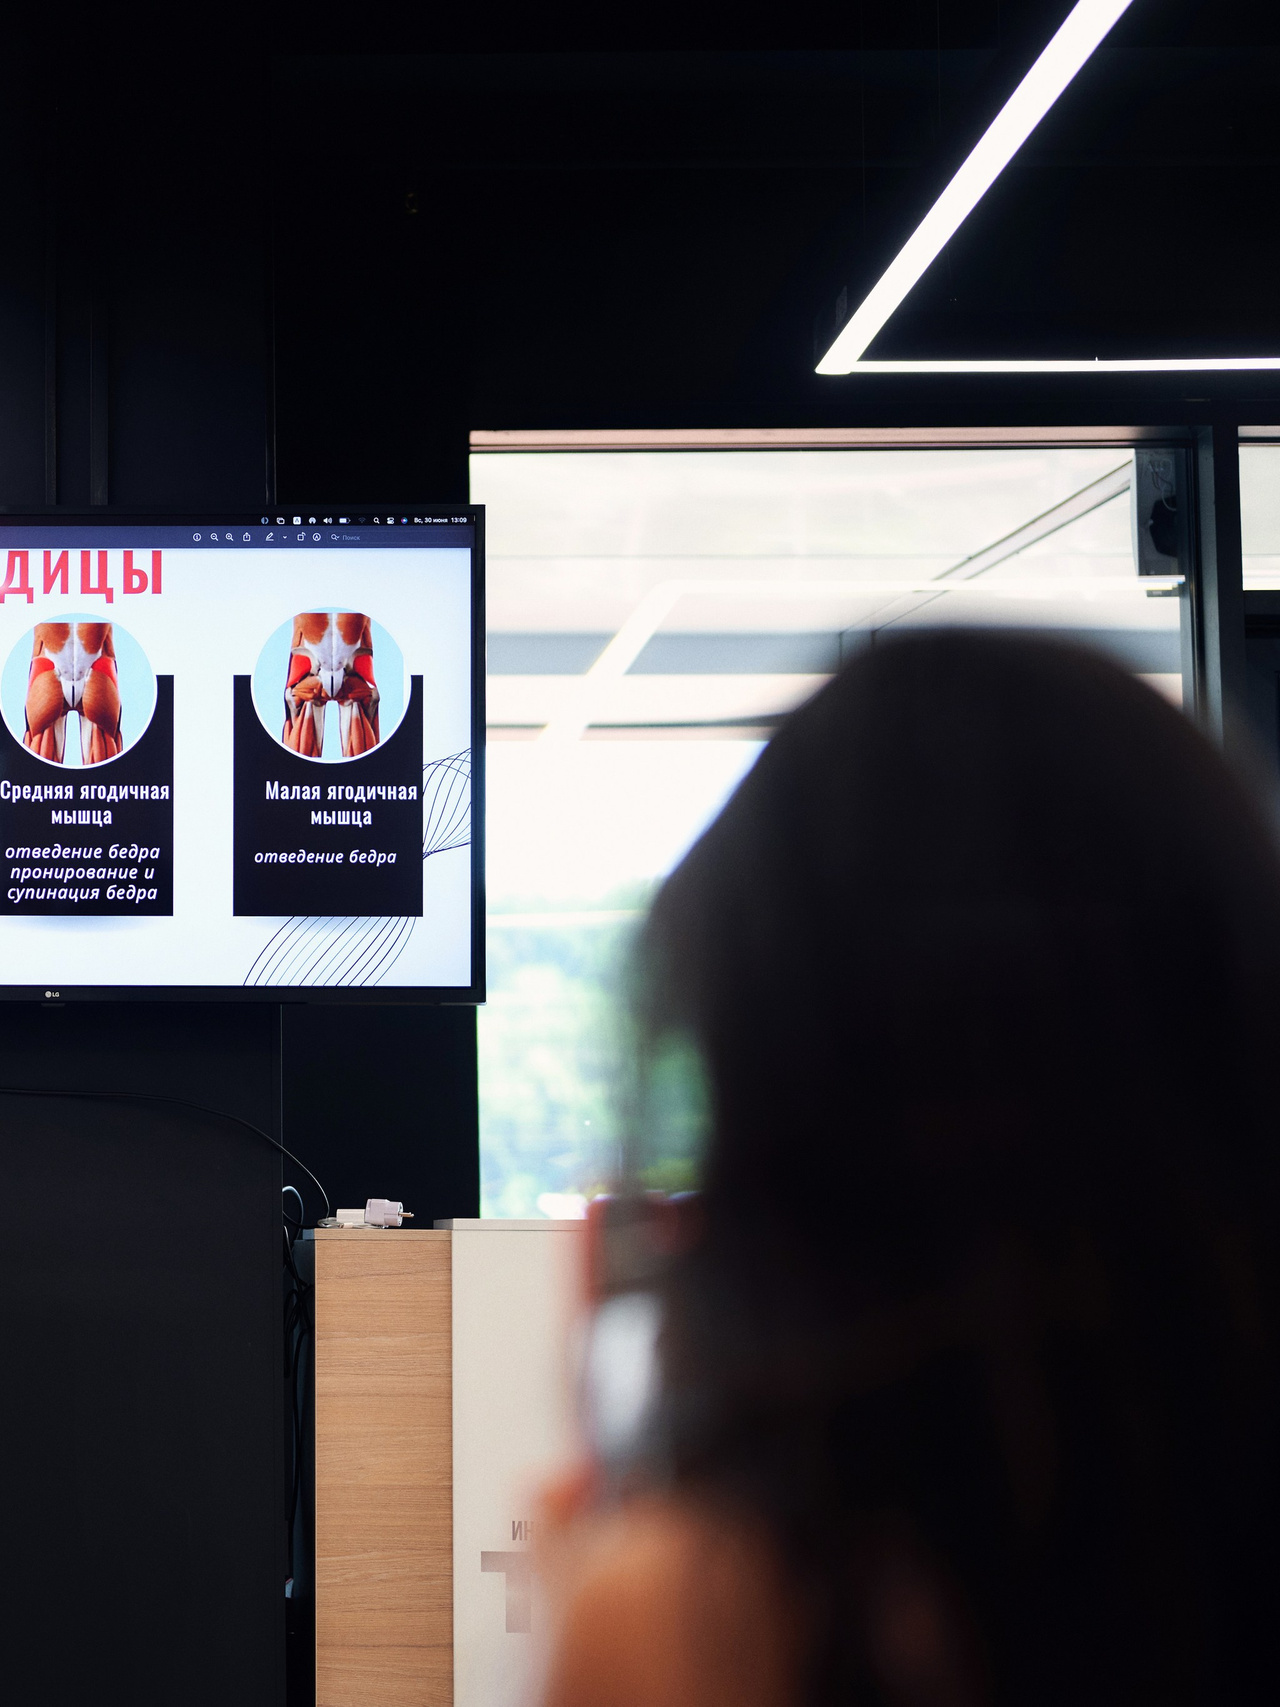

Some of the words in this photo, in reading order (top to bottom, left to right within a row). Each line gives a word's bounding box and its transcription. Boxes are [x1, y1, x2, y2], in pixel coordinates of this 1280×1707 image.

[0, 780, 74, 803] Средняя
[80, 785, 170, 803] ягодичная
[265, 780, 321, 800] Малая
[327, 785, 418, 803] ягодичная
[51, 809, 113, 828] мышца
[310, 810, 373, 828] мышца
[5, 843, 103, 859] отведение
[108, 843, 161, 863] бедра
[254, 849, 344, 864] отведение
[348, 849, 397, 867] бедра
[10, 866, 138, 883] пронирование
[144, 867, 155, 879] и
[7, 887, 100, 903] супинация
[106, 884, 158, 904] бедра
